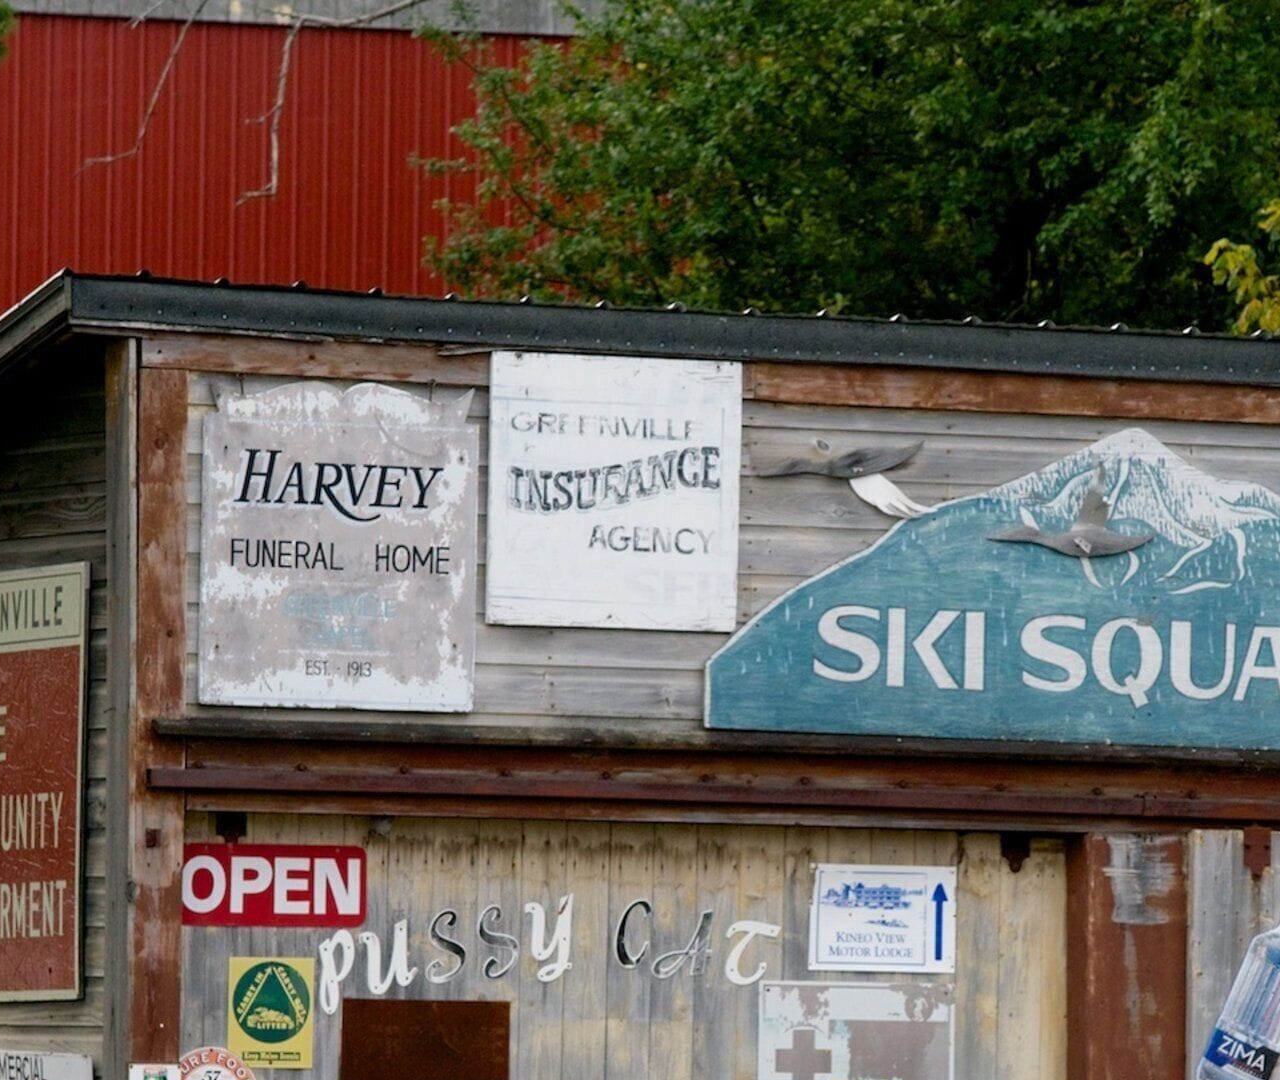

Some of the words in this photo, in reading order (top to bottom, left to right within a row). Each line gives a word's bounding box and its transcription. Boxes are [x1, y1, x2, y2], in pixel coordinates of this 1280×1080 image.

[233, 447, 444, 523] HARVEY
[507, 446, 722, 513] INSURANCE
[229, 537, 344, 572] FUNERAL
[374, 543, 451, 575] HOME
[588, 523, 717, 556] AGENCY
[304, 659, 331, 676] EST.
[346, 661, 373, 678] 1913
[813, 604, 986, 692] SKI
[181, 854, 363, 916] OPEN
[1218, 1034, 1266, 1073] ZIMA
